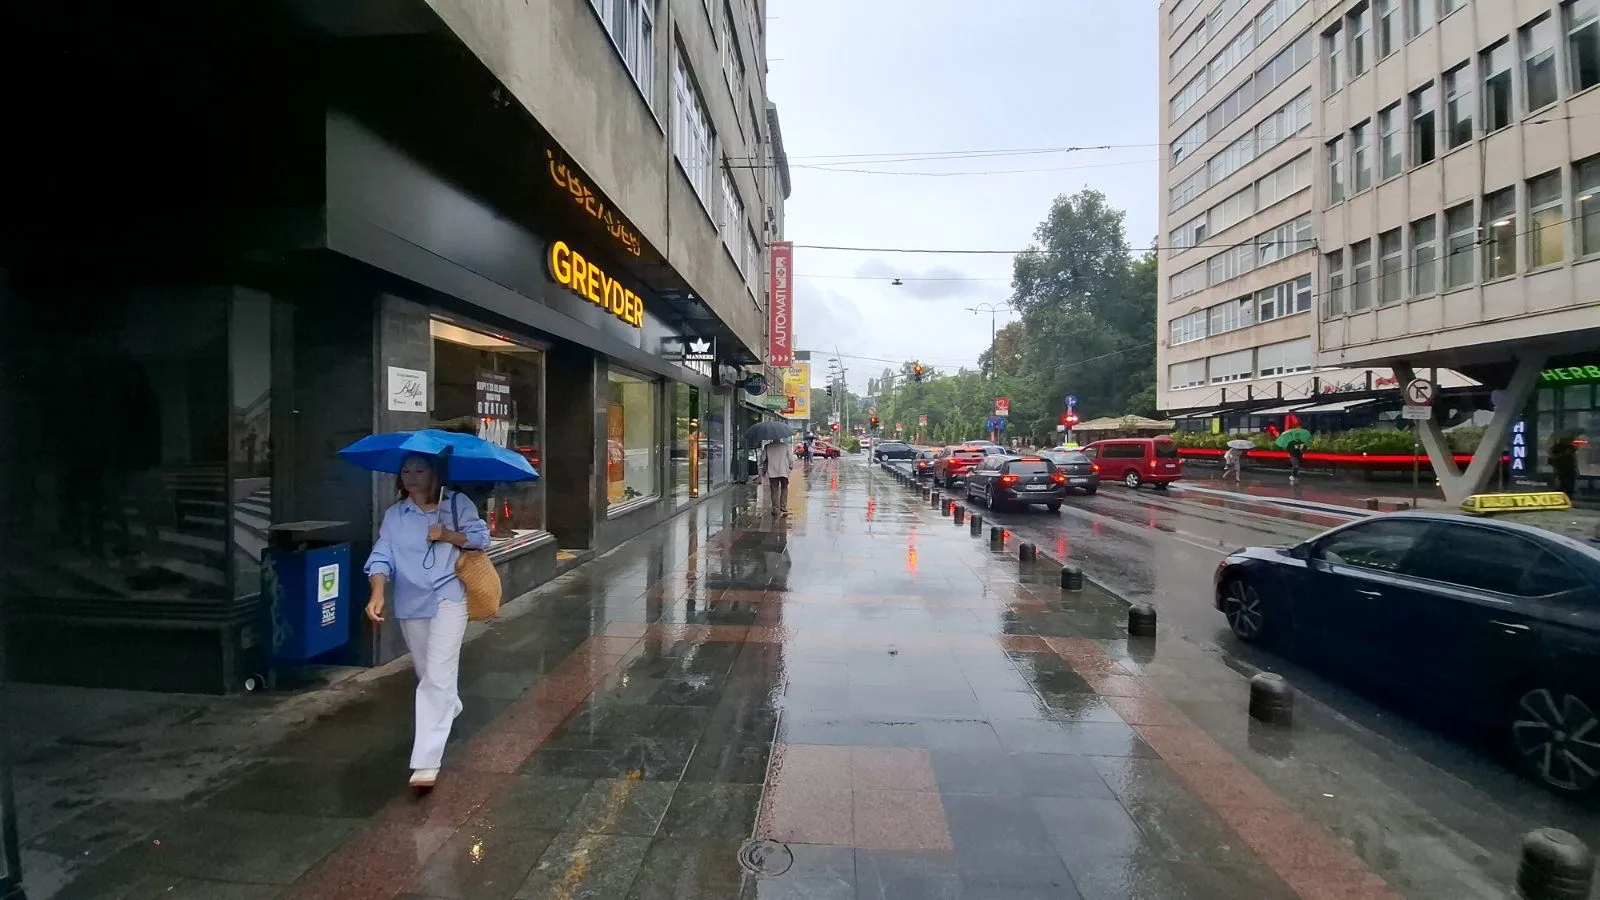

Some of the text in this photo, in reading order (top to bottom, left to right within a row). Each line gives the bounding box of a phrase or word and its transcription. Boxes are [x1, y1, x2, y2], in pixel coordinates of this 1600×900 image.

[551, 241, 643, 328] GREYDER
[477, 401, 508, 416] GRATIS
[1512, 421, 1525, 470] HANA
